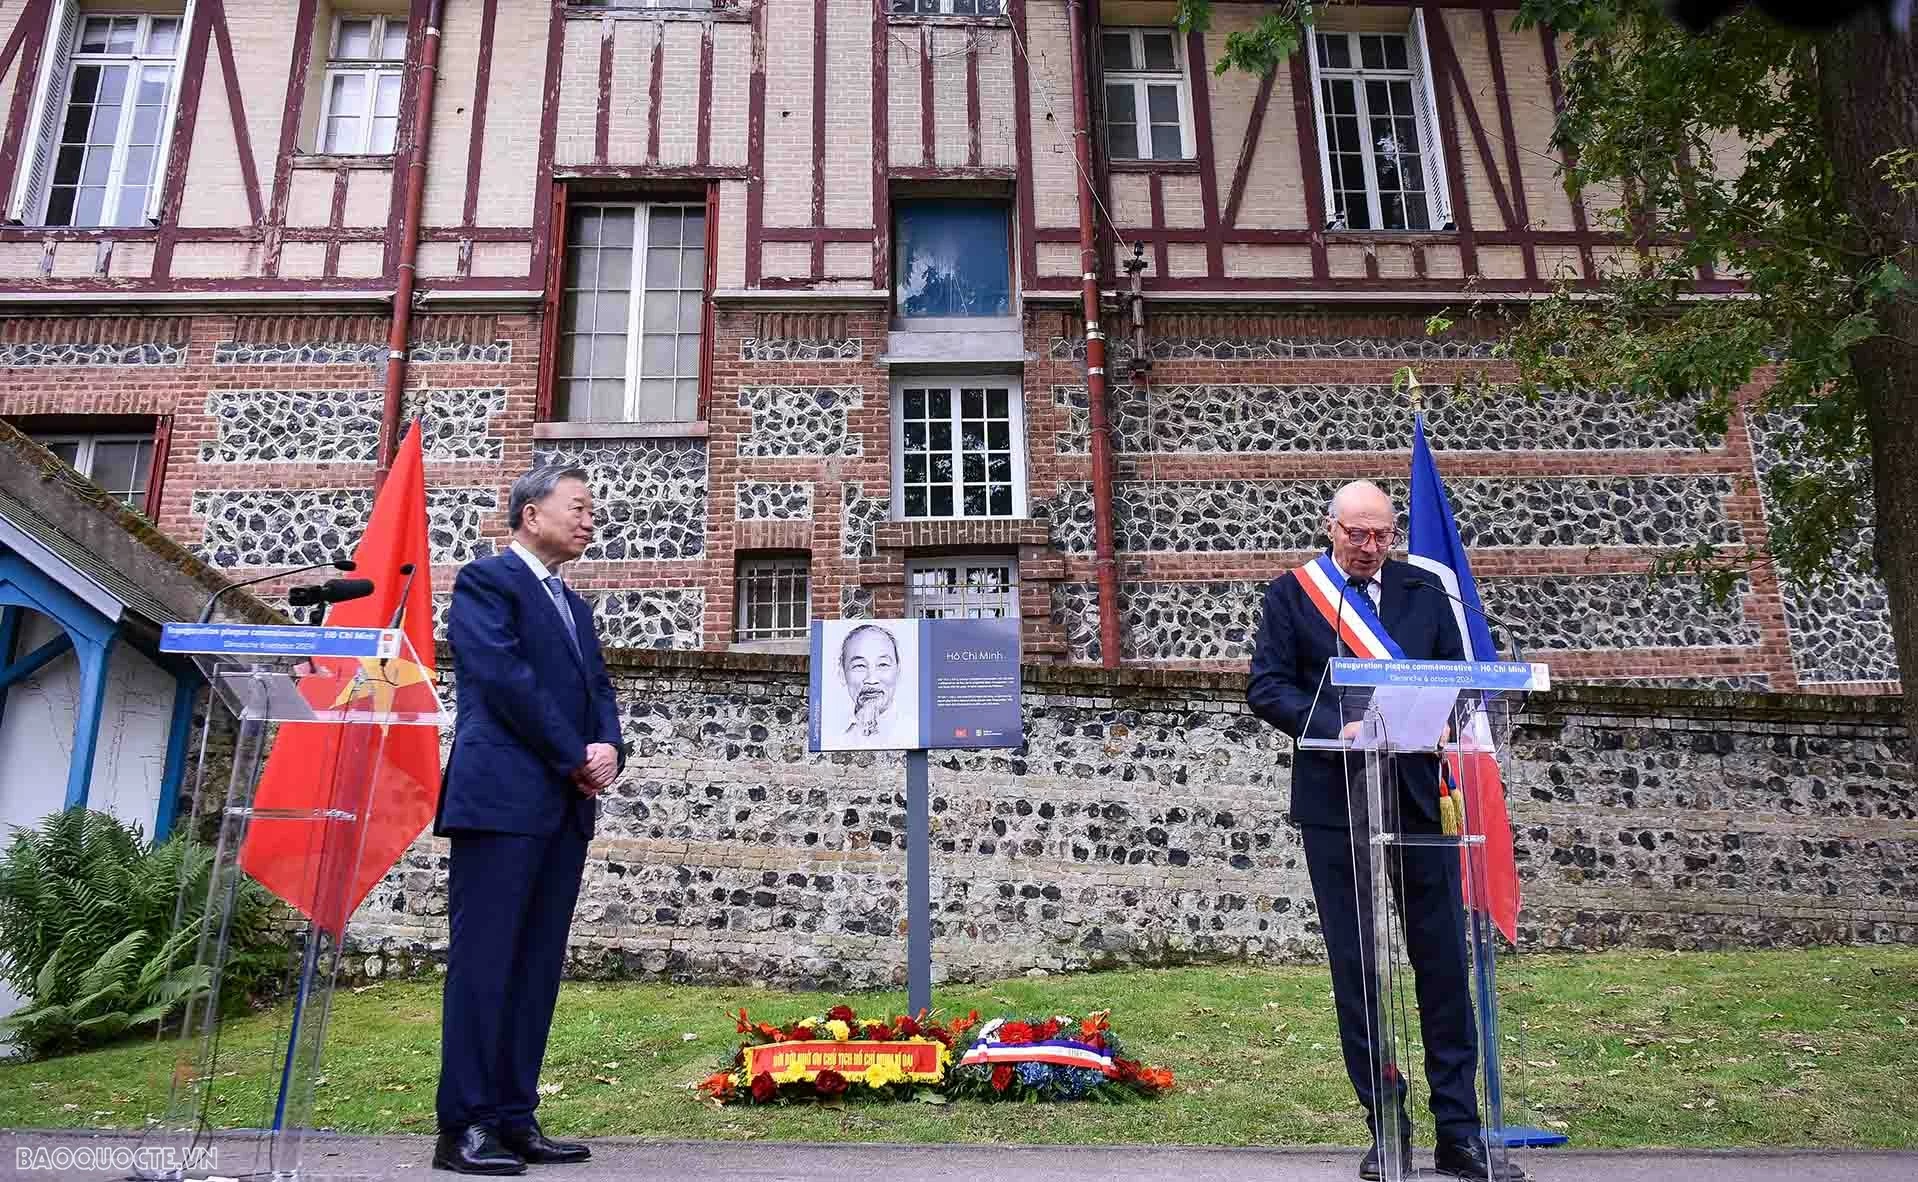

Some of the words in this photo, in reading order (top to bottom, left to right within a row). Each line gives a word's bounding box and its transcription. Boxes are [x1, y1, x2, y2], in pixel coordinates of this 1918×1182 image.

[962, 651, 977, 660] Chi
[980, 651, 1003, 660] Minh
[1335, 661, 1383, 670] Inauguration
[1385, 662, 1410, 671] plaque
[1412, 663, 1472, 671] commémorative
[1508, 664, 1527, 673] Minh
